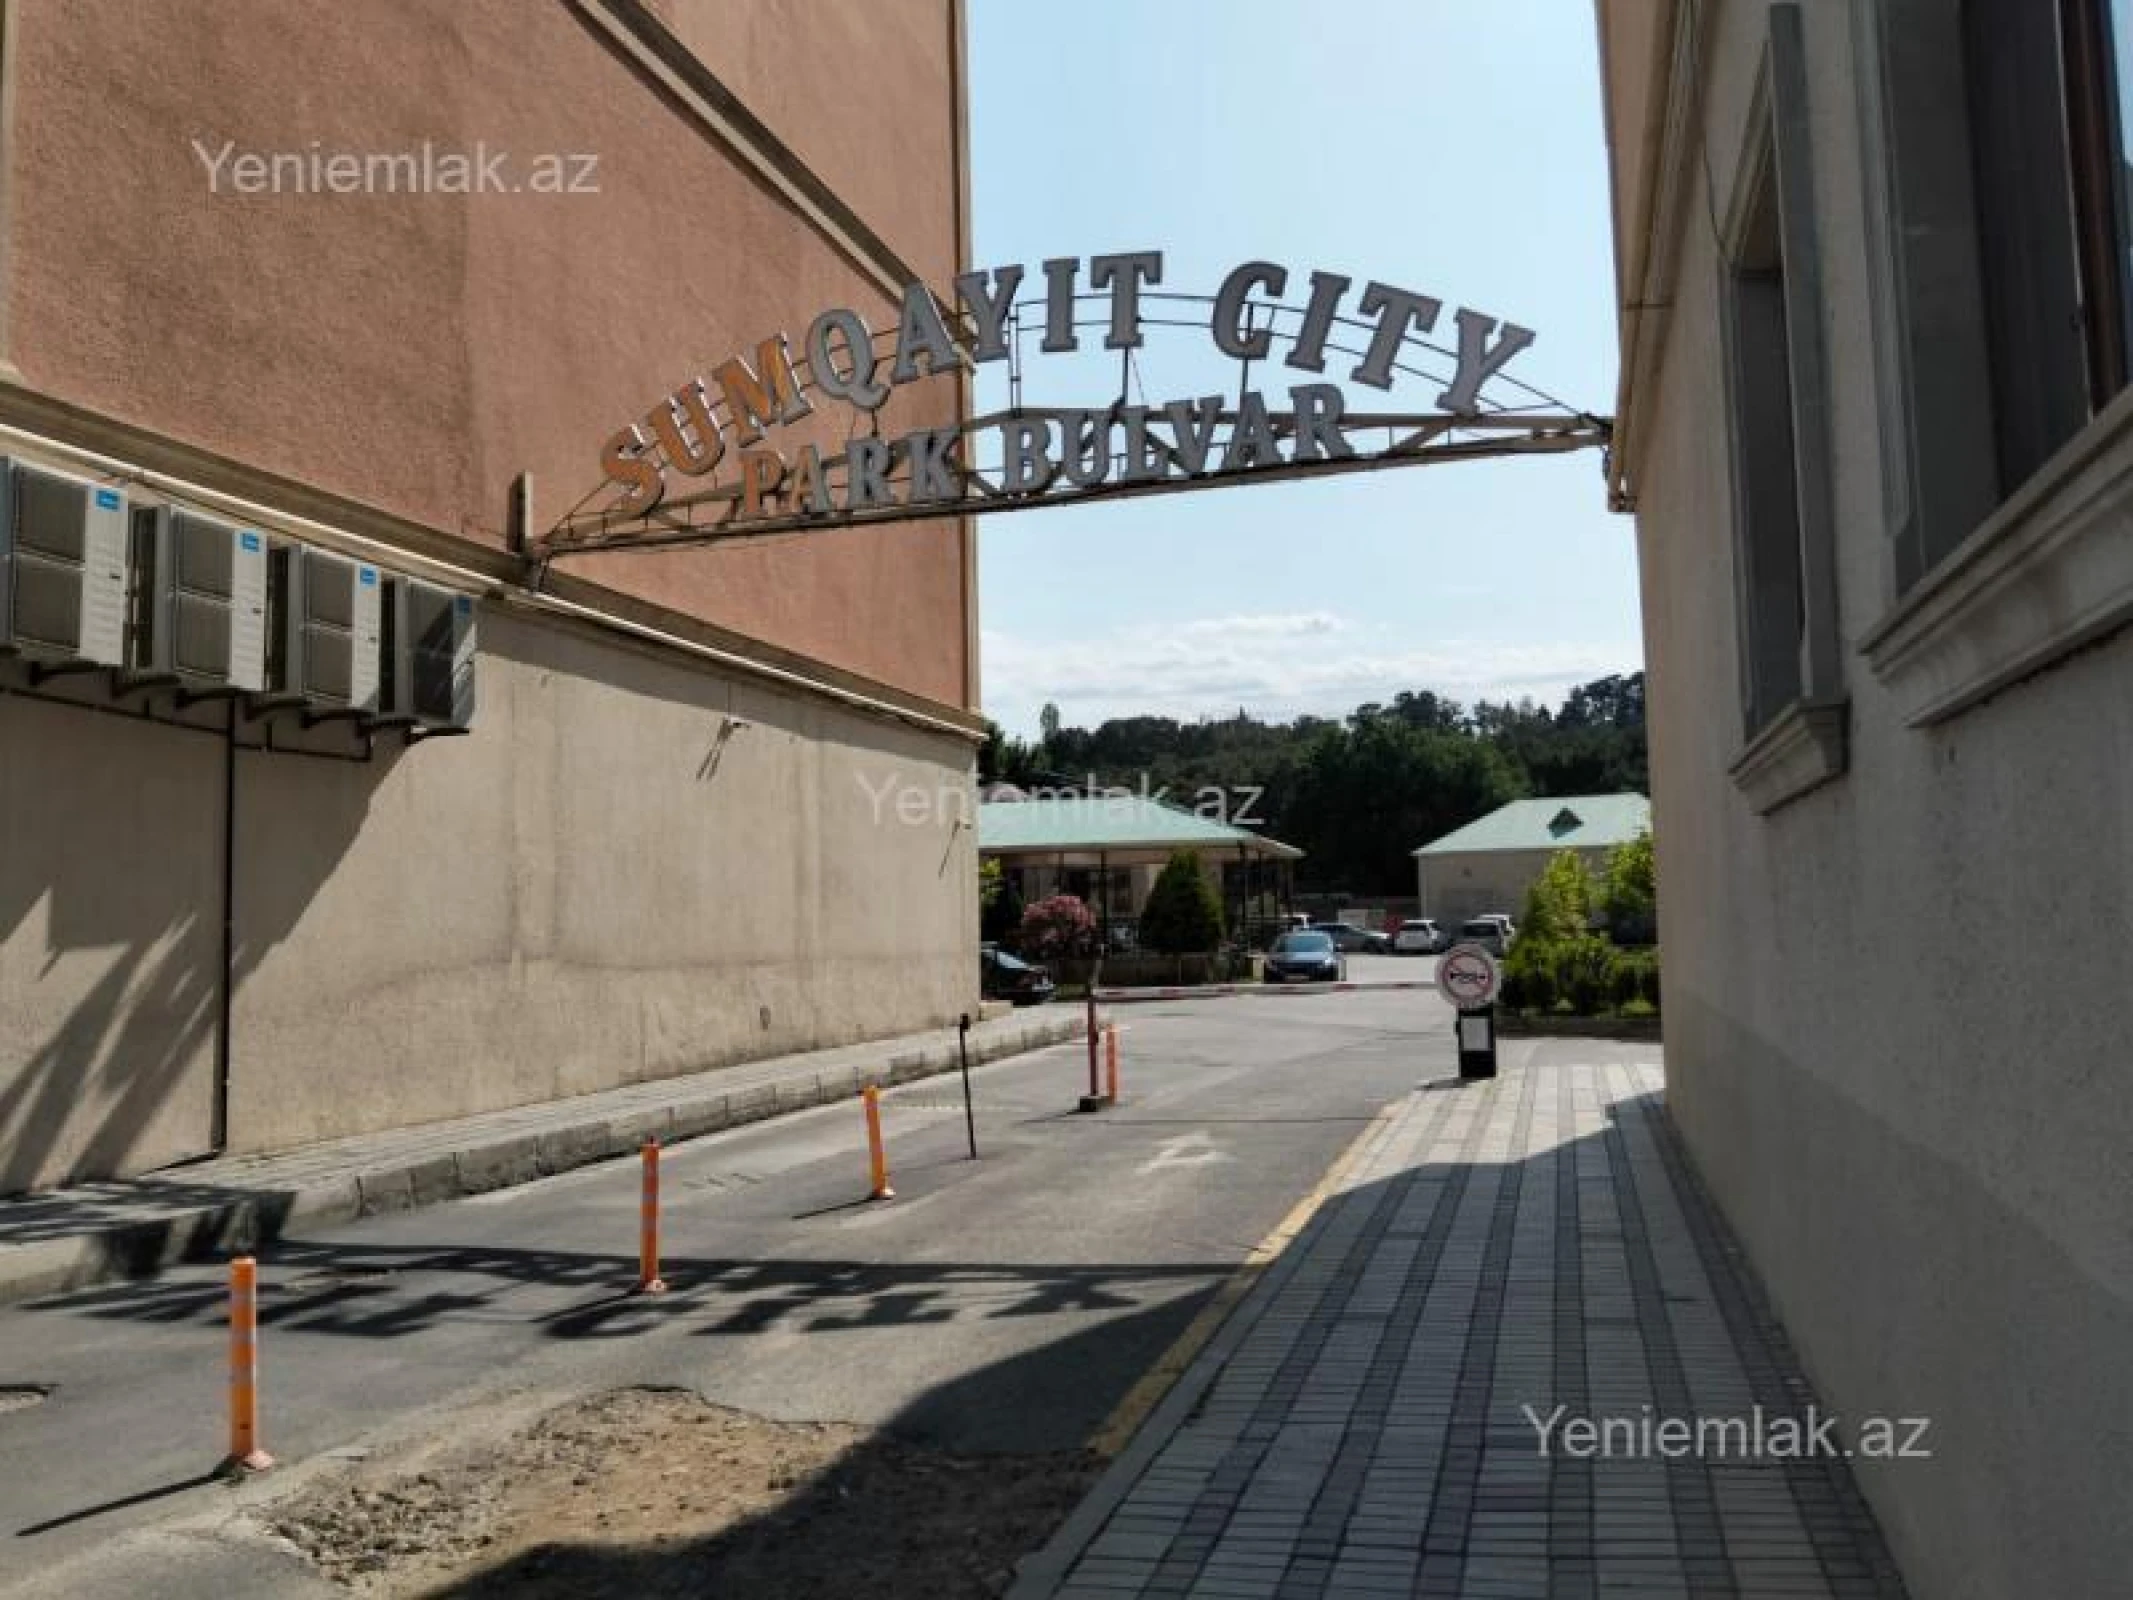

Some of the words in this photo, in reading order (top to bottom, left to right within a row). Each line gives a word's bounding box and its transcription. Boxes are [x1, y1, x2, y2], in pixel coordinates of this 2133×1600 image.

[600, 250, 1163, 518] SUMQAYIT
[1211, 260, 1537, 417] CITY
[736, 425, 966, 518] PARK
[1000, 383, 1357, 494] BULVAR
